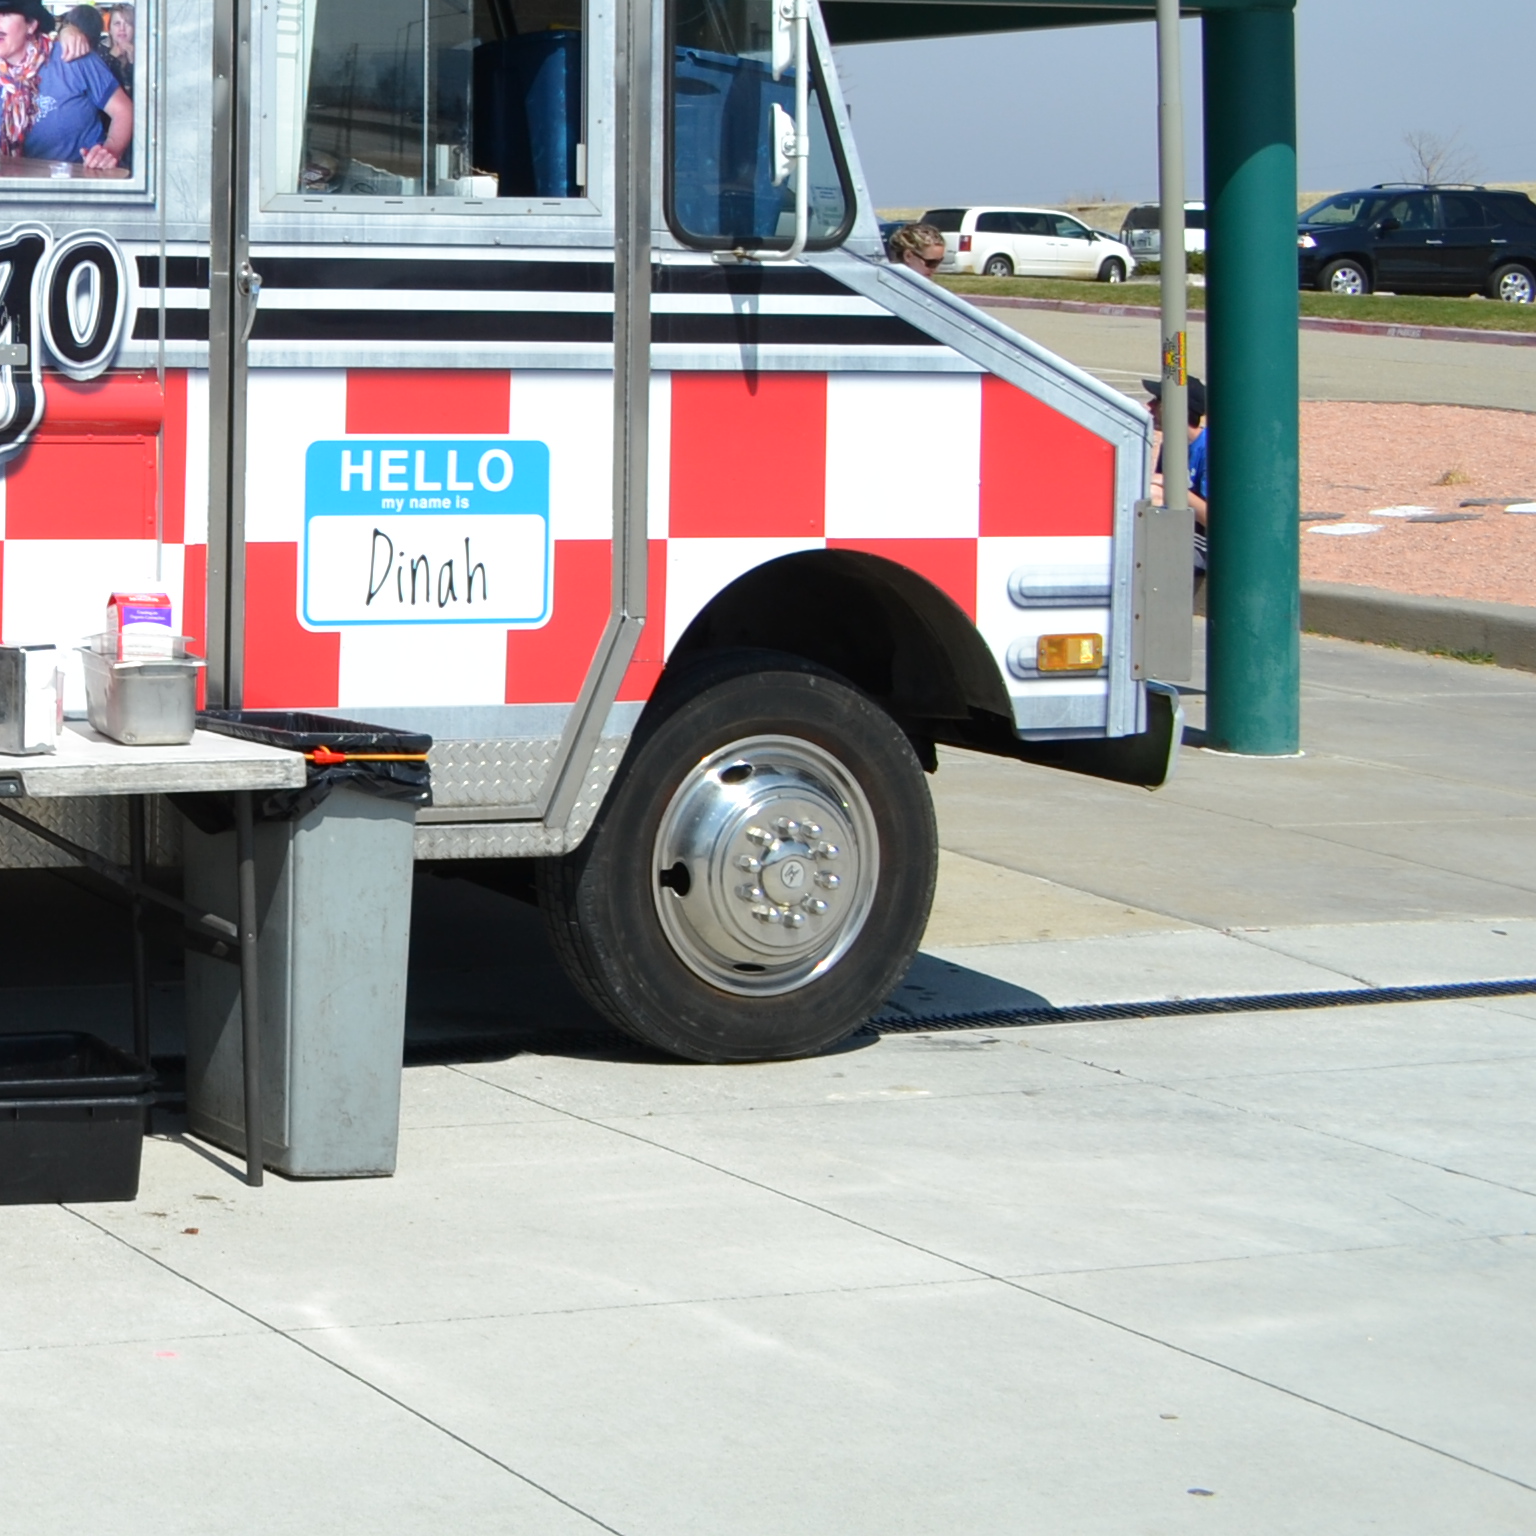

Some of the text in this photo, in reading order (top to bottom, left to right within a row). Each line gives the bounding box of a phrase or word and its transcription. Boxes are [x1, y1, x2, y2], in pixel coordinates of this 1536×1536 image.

[341, 449, 514, 492] HELLO
[381, 495, 470, 512] my name is
[365, 528, 488, 609] Dinah
